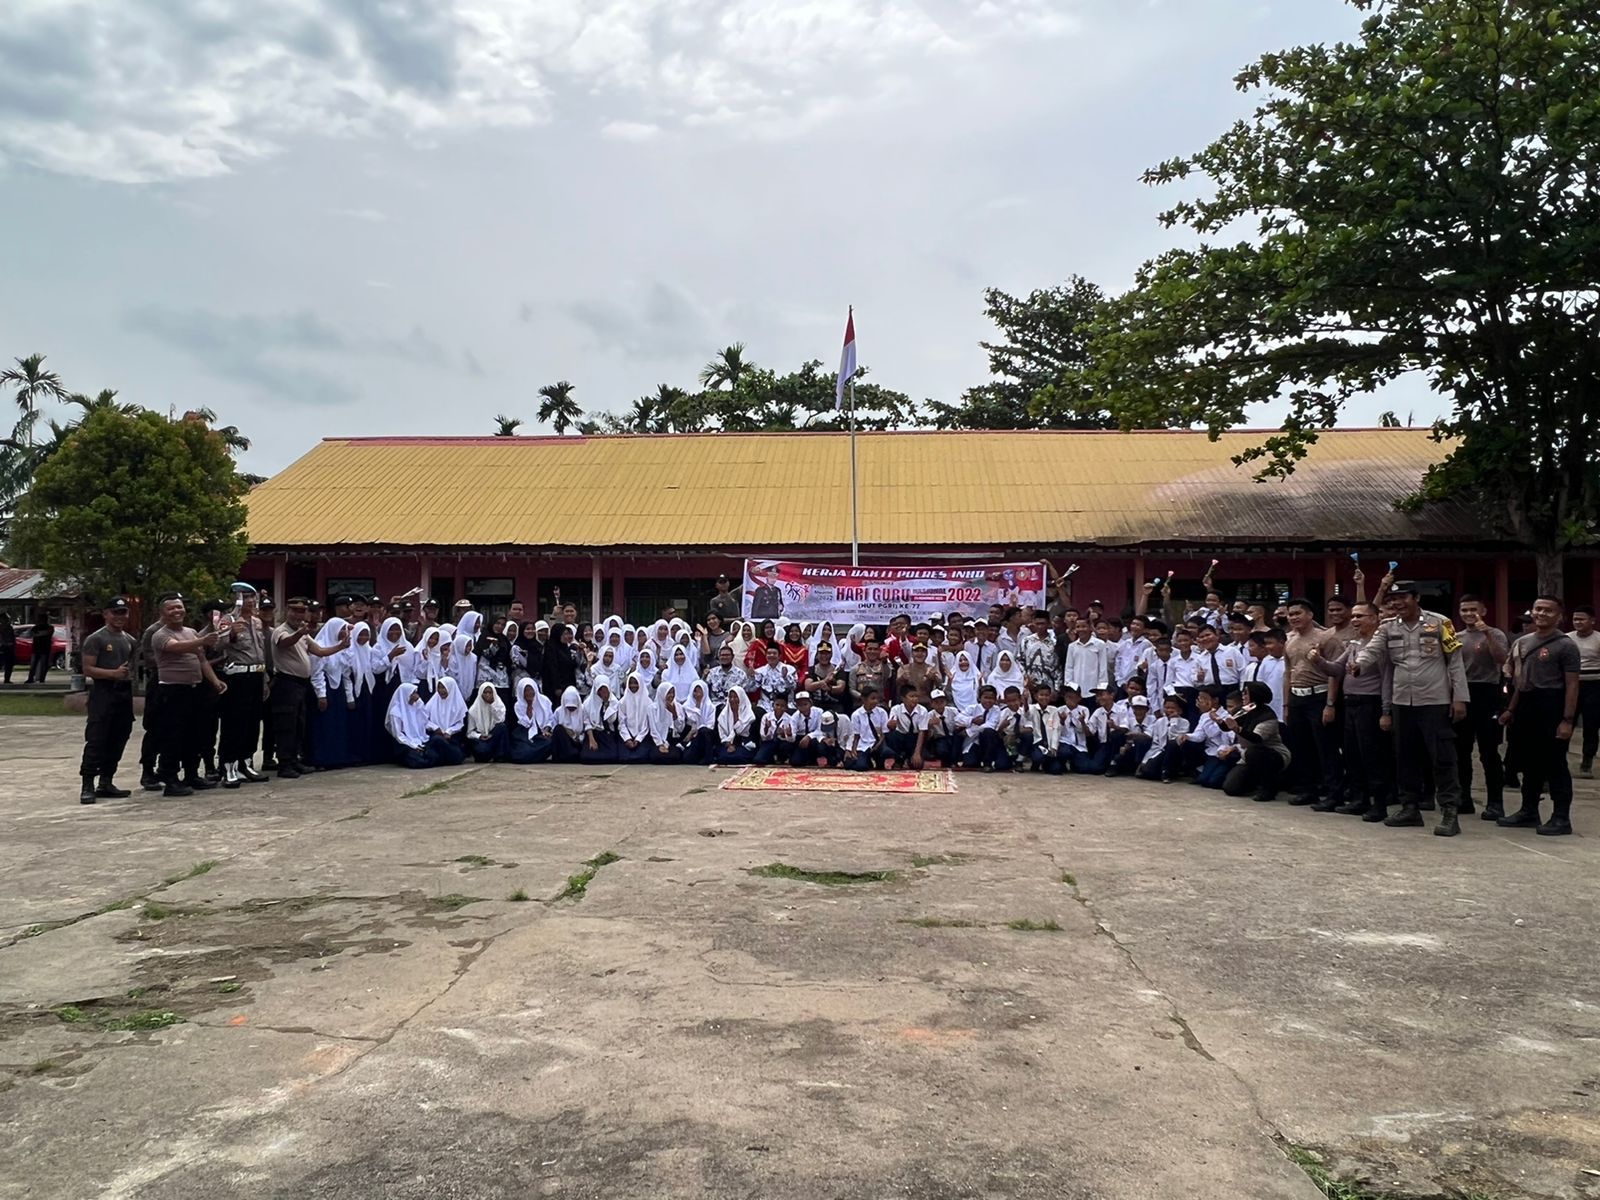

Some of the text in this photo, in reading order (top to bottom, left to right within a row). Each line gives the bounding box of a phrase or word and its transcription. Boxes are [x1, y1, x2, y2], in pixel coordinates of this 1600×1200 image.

[802, 567, 847, 577] KERJA
[896, 570, 948, 579] POLRES
[836, 587, 911, 602] HARI GURU
[948, 587, 982, 602] 2022
